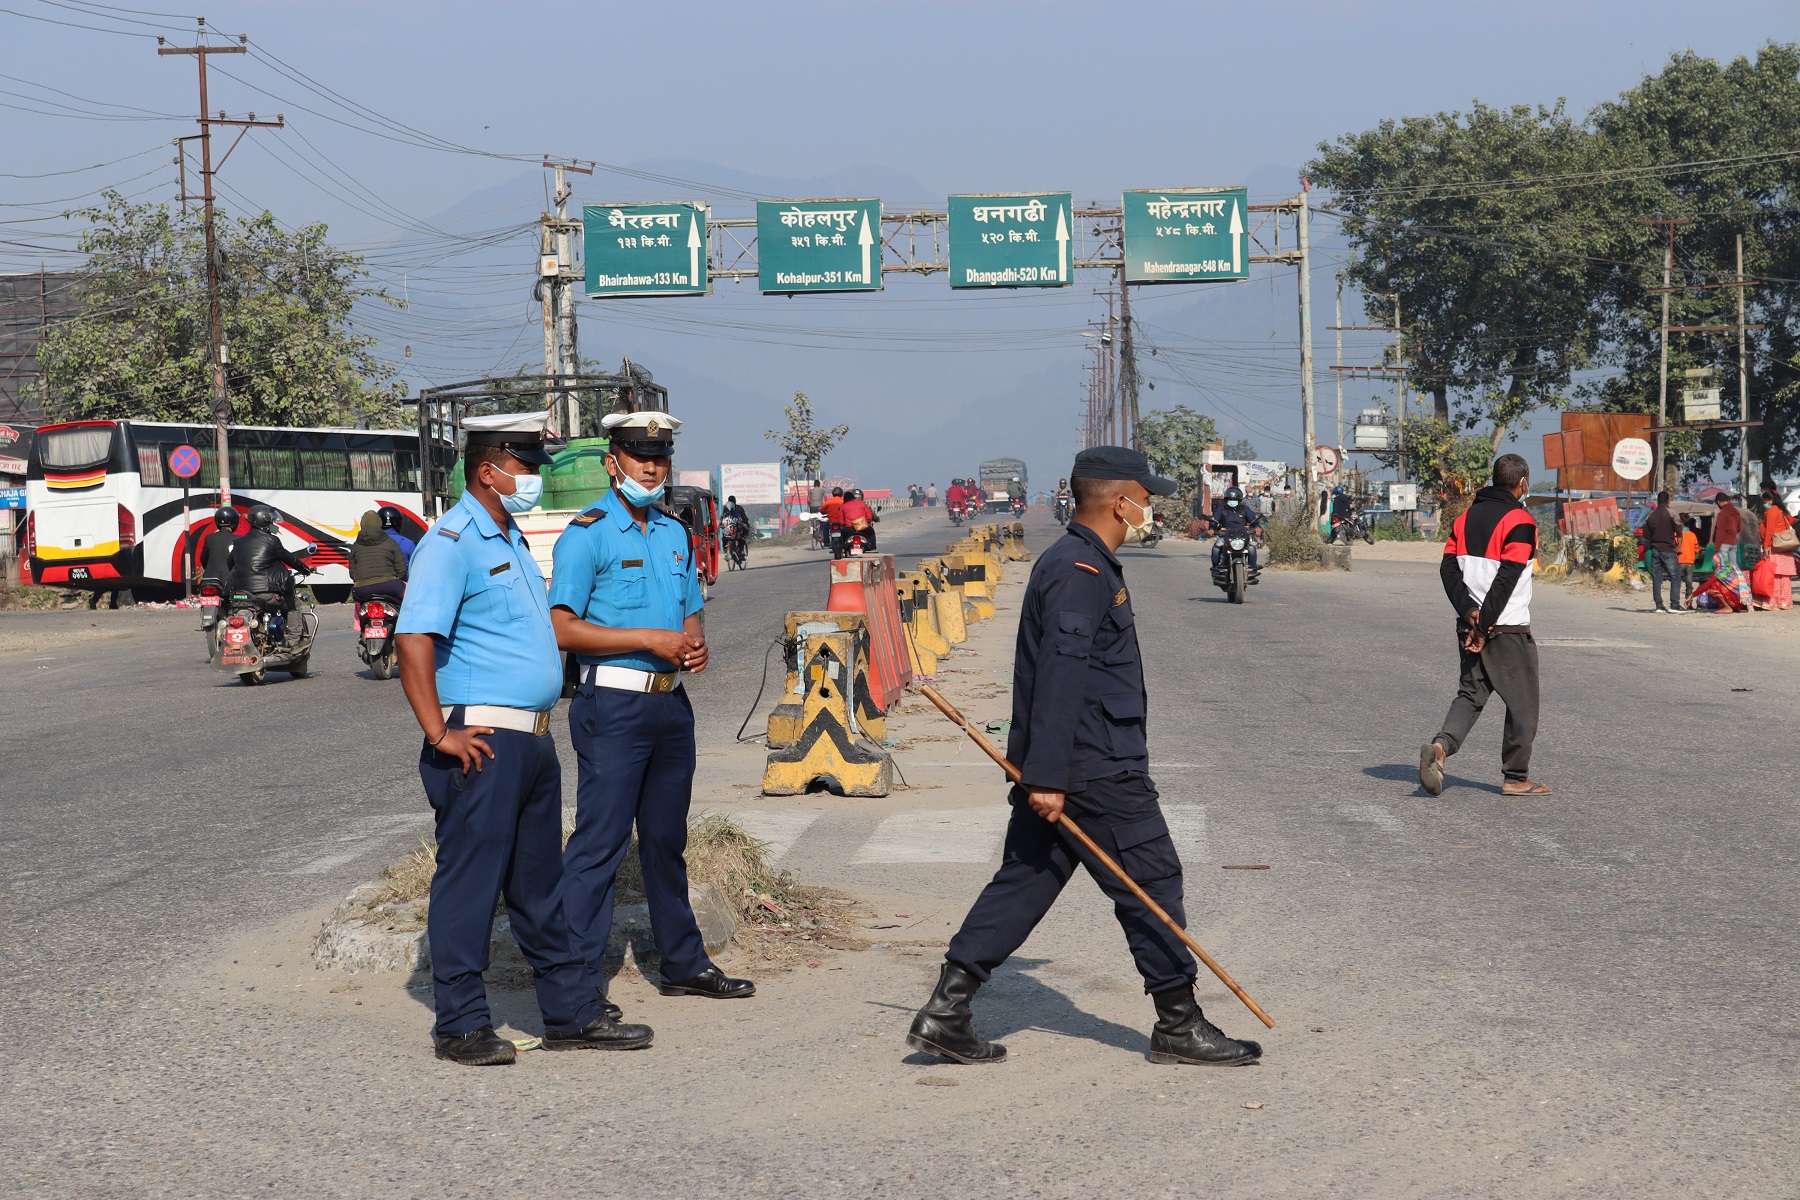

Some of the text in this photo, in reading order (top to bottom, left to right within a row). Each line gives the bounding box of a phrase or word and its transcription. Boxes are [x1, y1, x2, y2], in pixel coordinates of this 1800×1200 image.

[972, 199, 1048, 223] धनगढी
[1146, 196, 1227, 220] महेन्द्रनगर
[608, 208, 681, 230] भैरहवा
[779, 206, 858, 231] कोहलपुर
[981, 232, 1005, 245] ५२०
[1155, 226, 1182, 238] ५४८
[617, 237, 637, 249] १३३
[791, 236, 811, 248] ३५१
[1144, 260, 1231, 276] Mahendranagar-548 Km
[599, 272, 688, 287] Bhairahawa-133 Km
[776, 271, 862, 286] Kohalpur-351 Km
[966, 267, 1057, 286] Dhangadhi-520 Km
